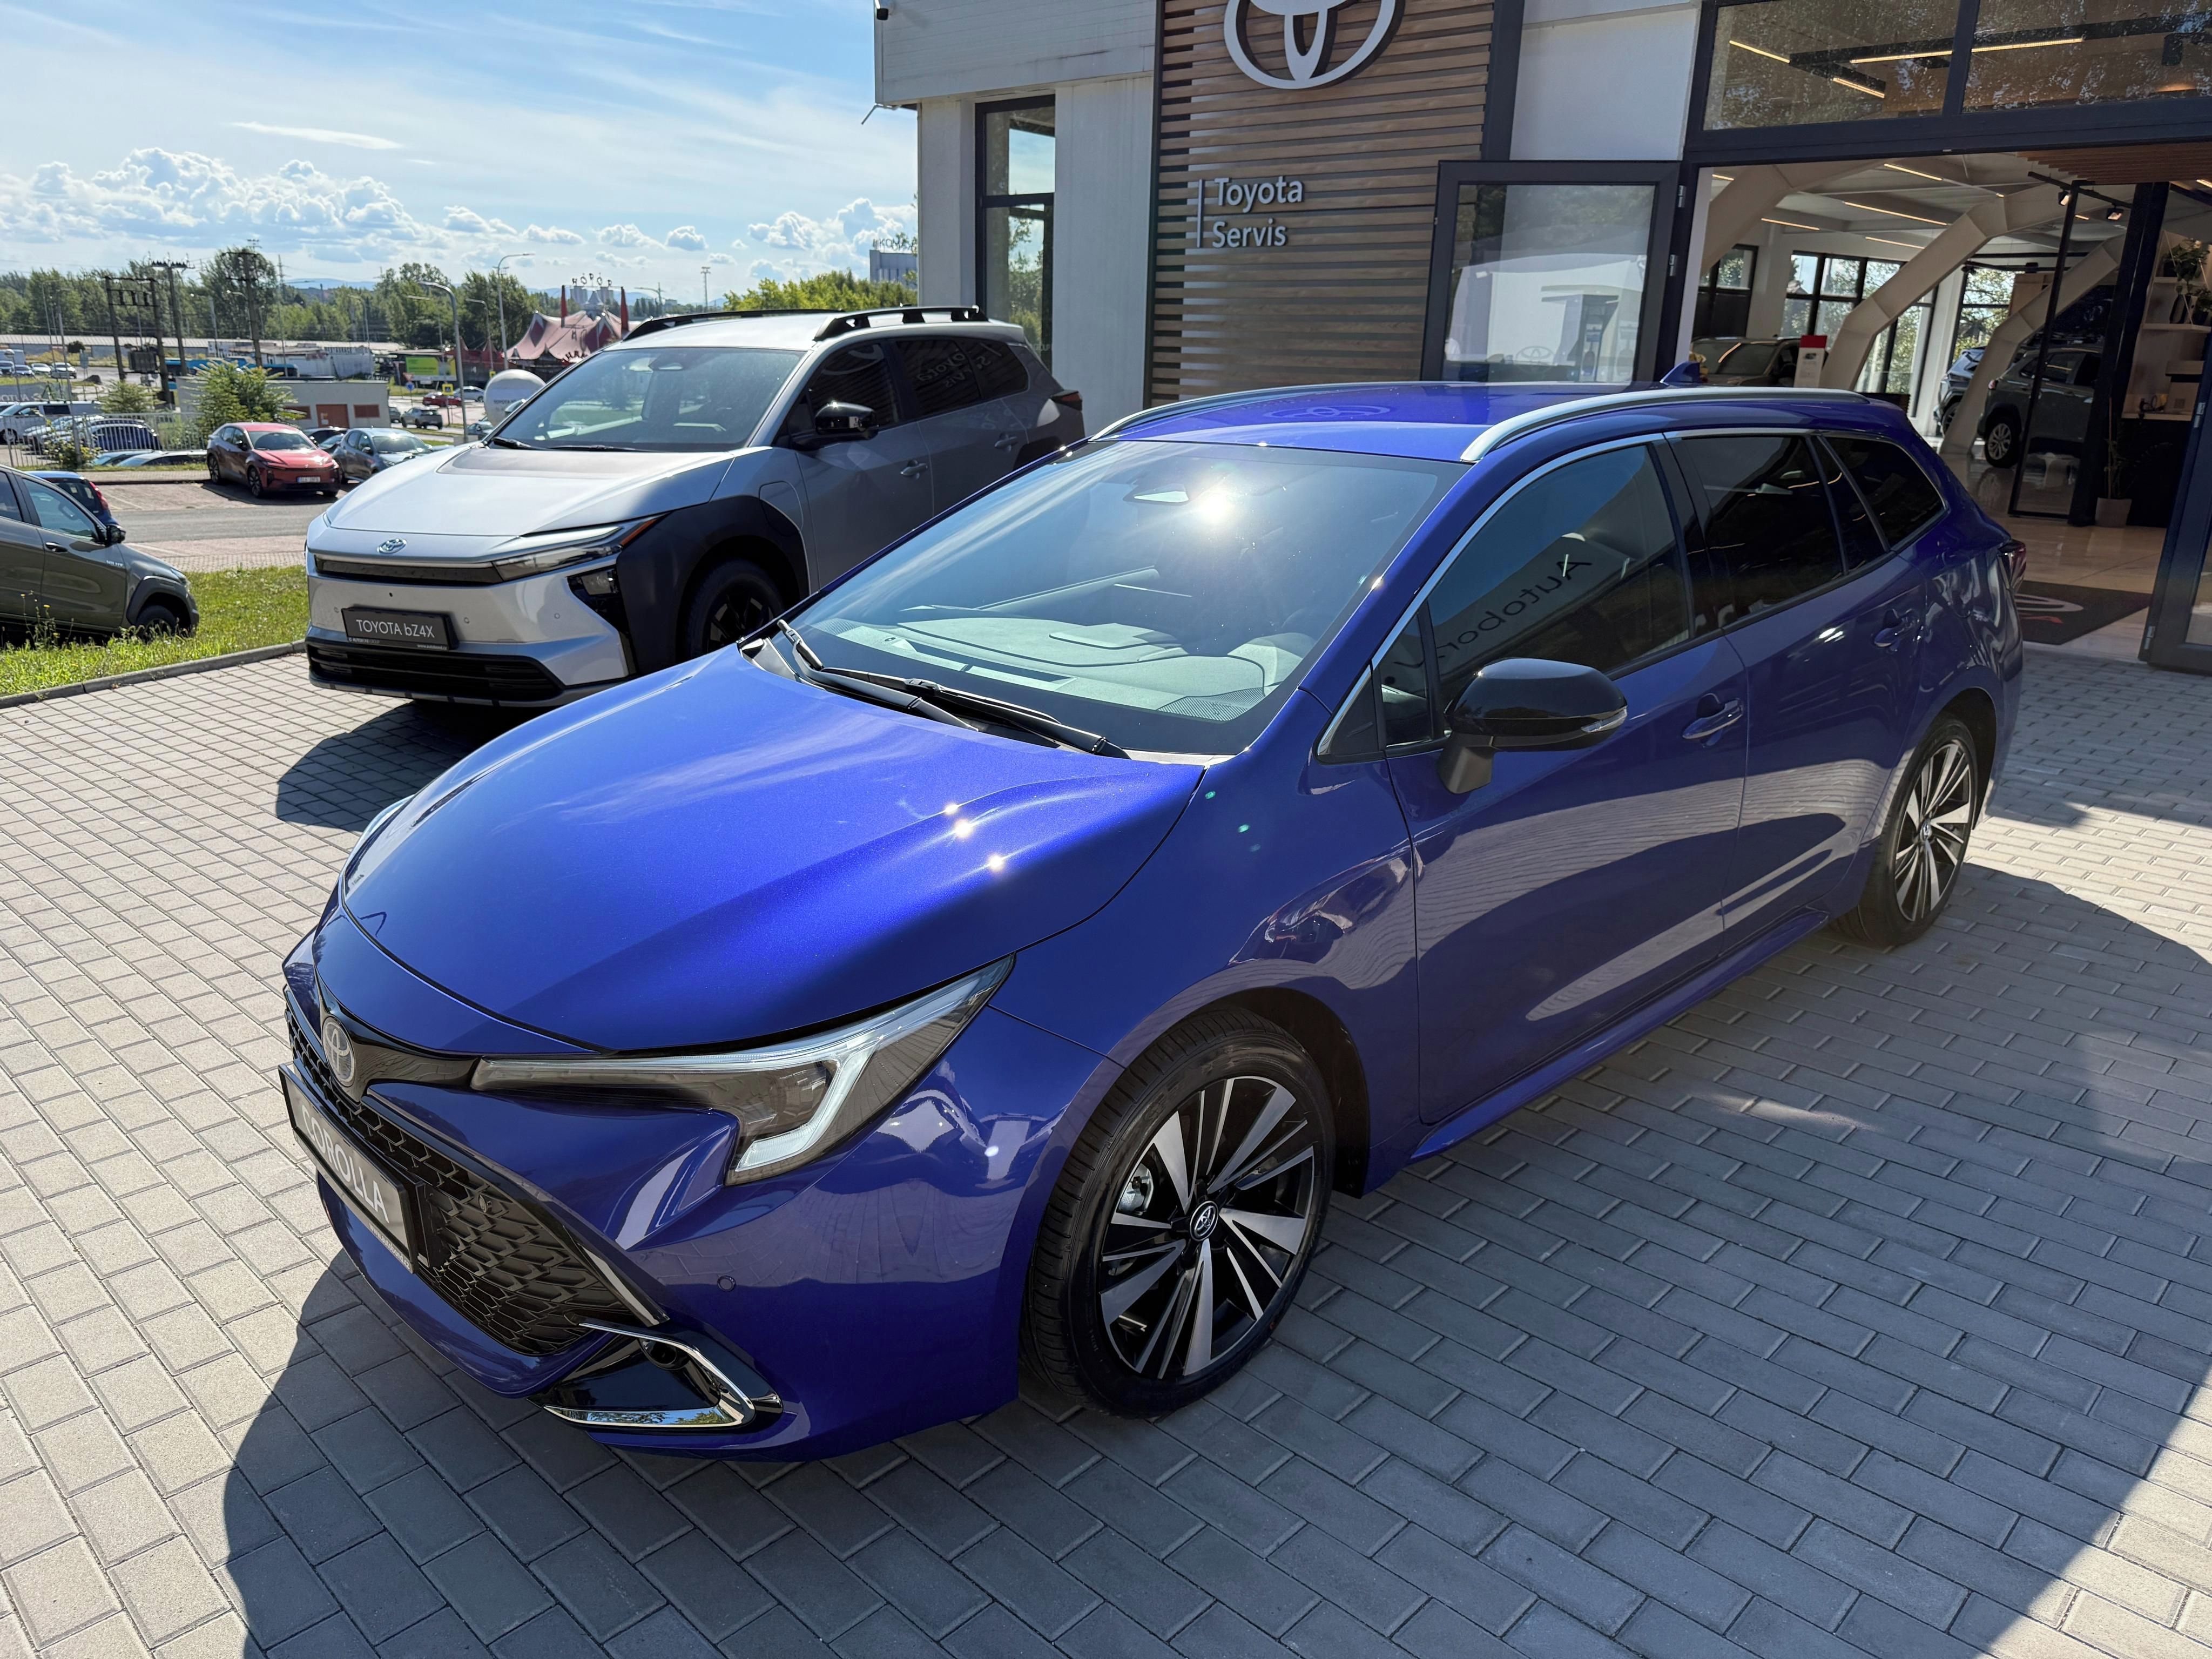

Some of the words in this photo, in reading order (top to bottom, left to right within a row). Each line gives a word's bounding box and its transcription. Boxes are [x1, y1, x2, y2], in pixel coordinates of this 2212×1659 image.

[1214, 176, 1304, 213] Toyota
[1212, 218, 1287, 248] Servis
[356, 619, 402, 636] TOYOTA
[404, 623, 435, 638] bZ4X
[301, 1104, 389, 1223] COROLLA
